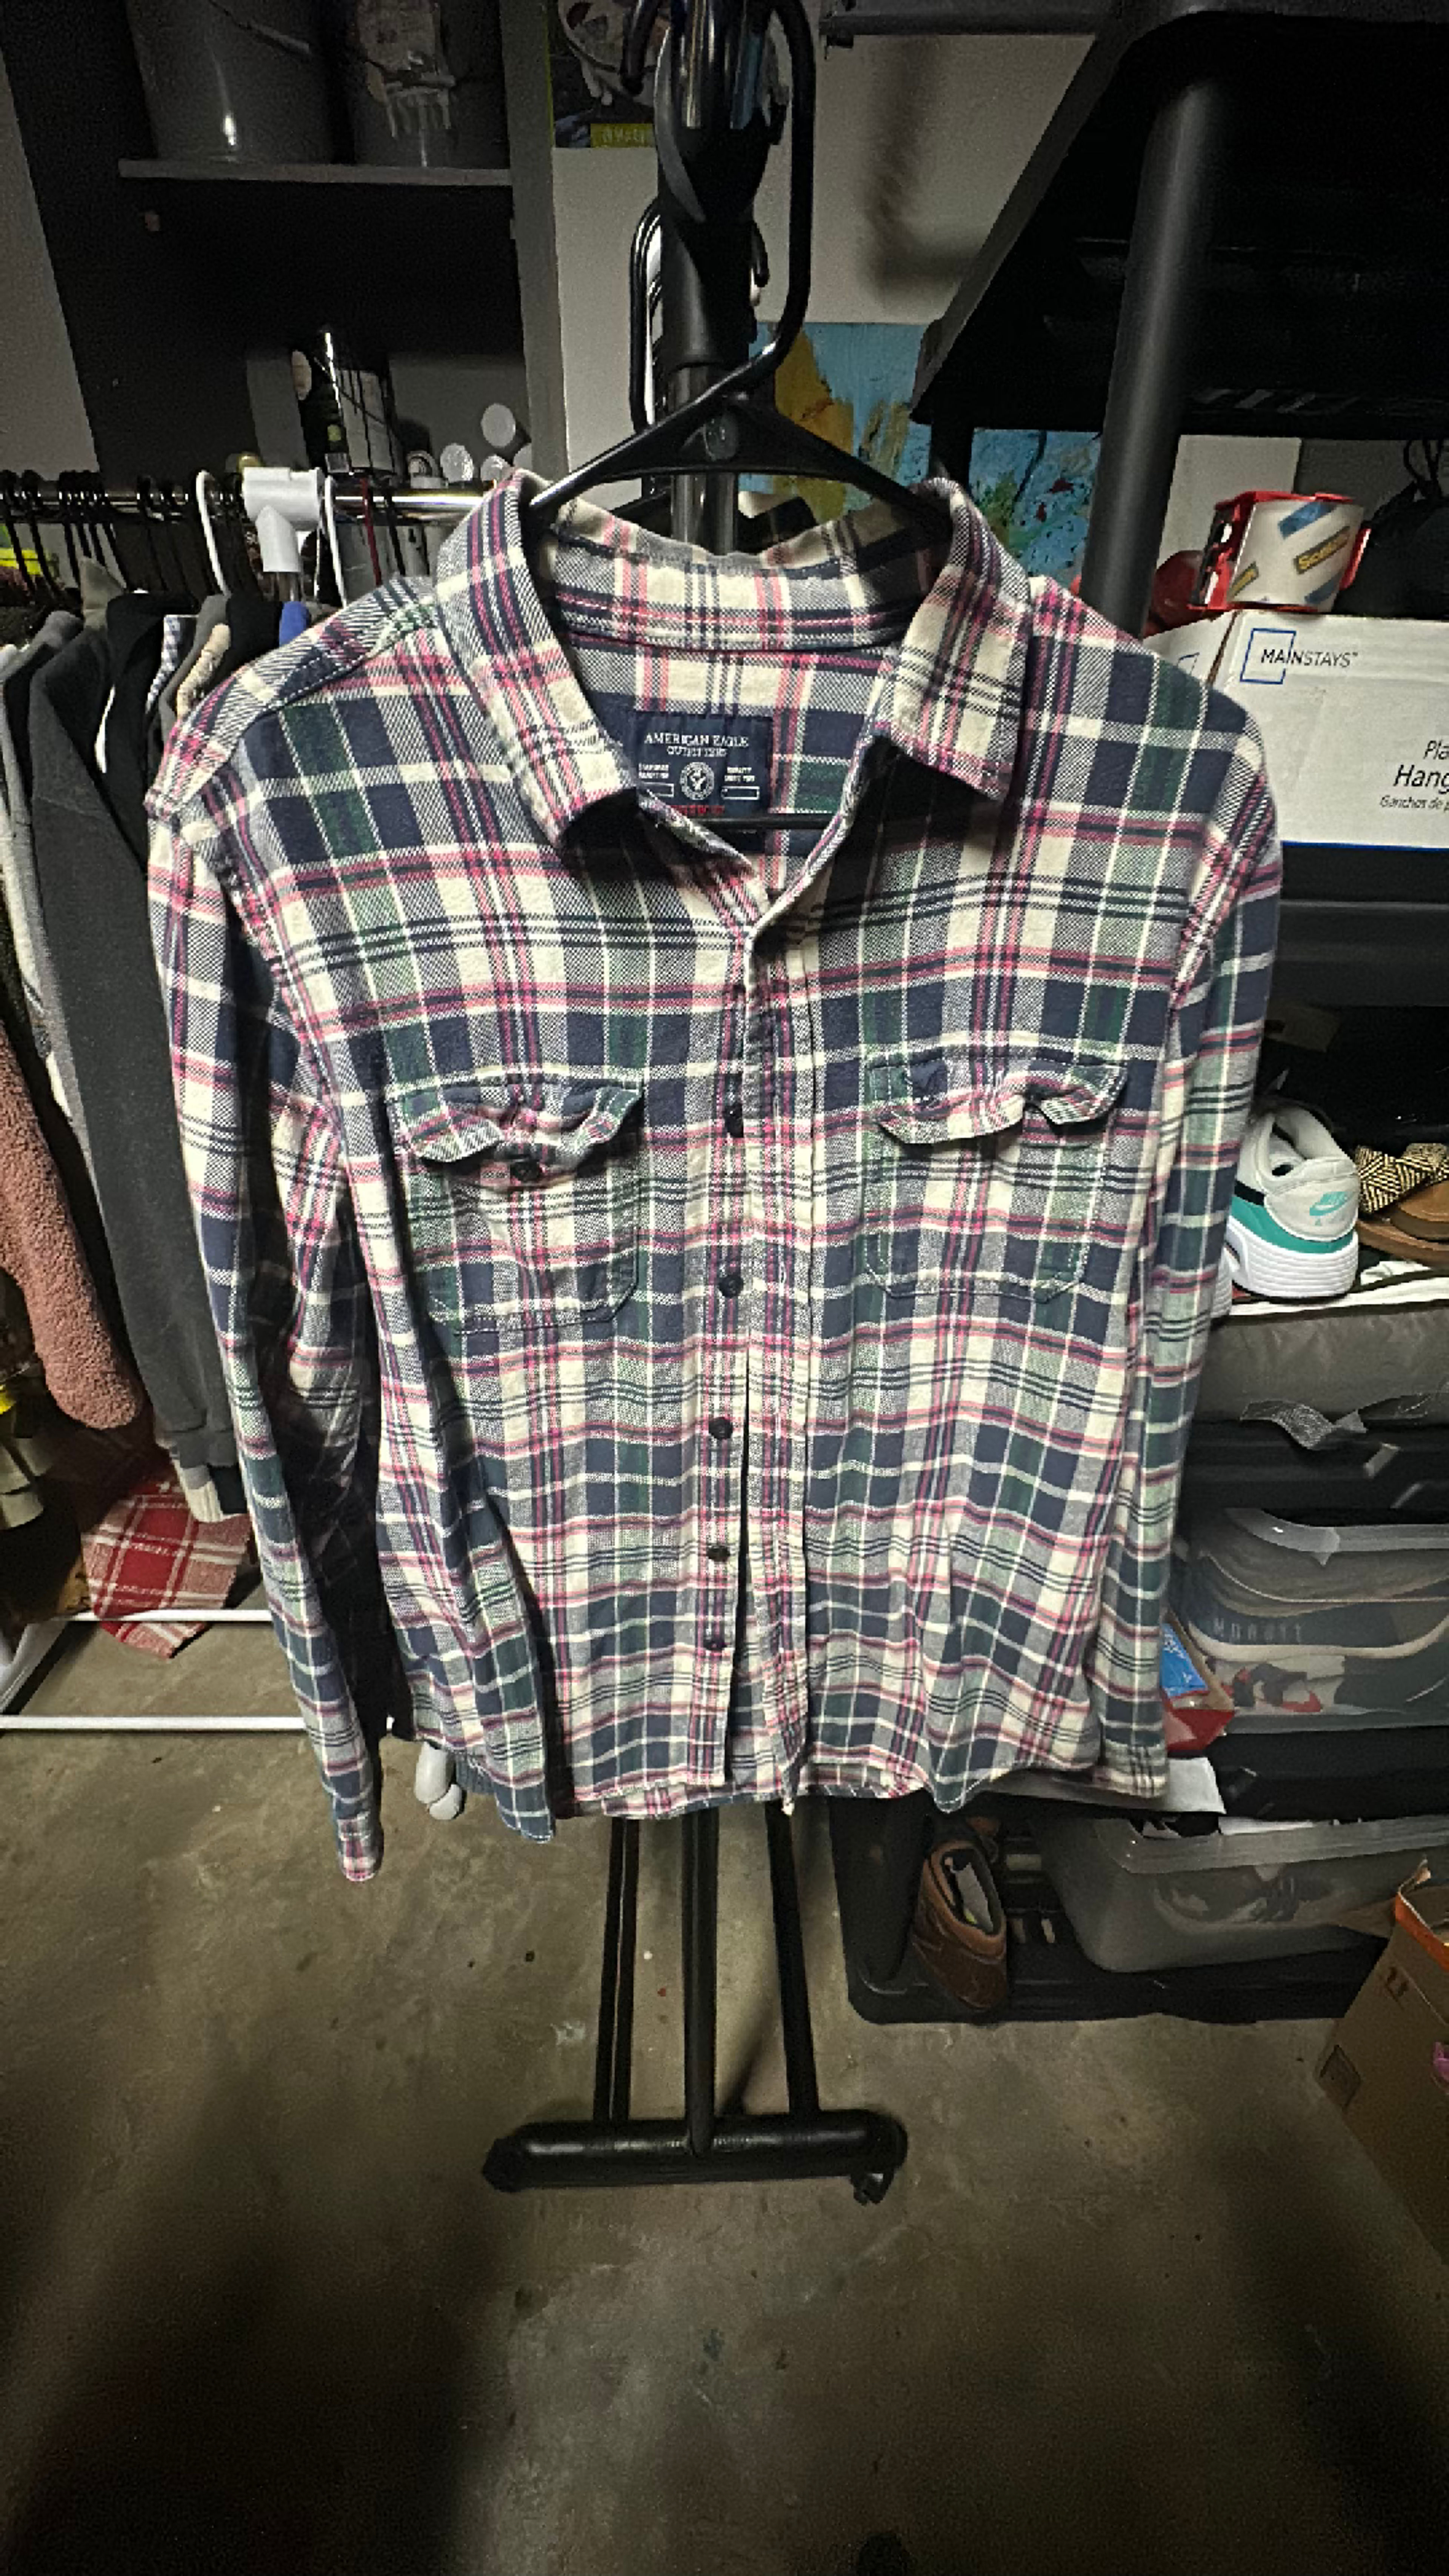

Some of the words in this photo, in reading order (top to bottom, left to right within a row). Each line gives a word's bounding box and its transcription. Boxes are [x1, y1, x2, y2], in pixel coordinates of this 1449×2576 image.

[1261, 649, 1351, 667] MAINSTAYS
[644, 732, 709, 746] AMERICAN
[713, 735, 750, 747] EAGLE
[666, 746, 728, 757] OUTFITTERS
[1393, 764, 1449, 795] Hang
